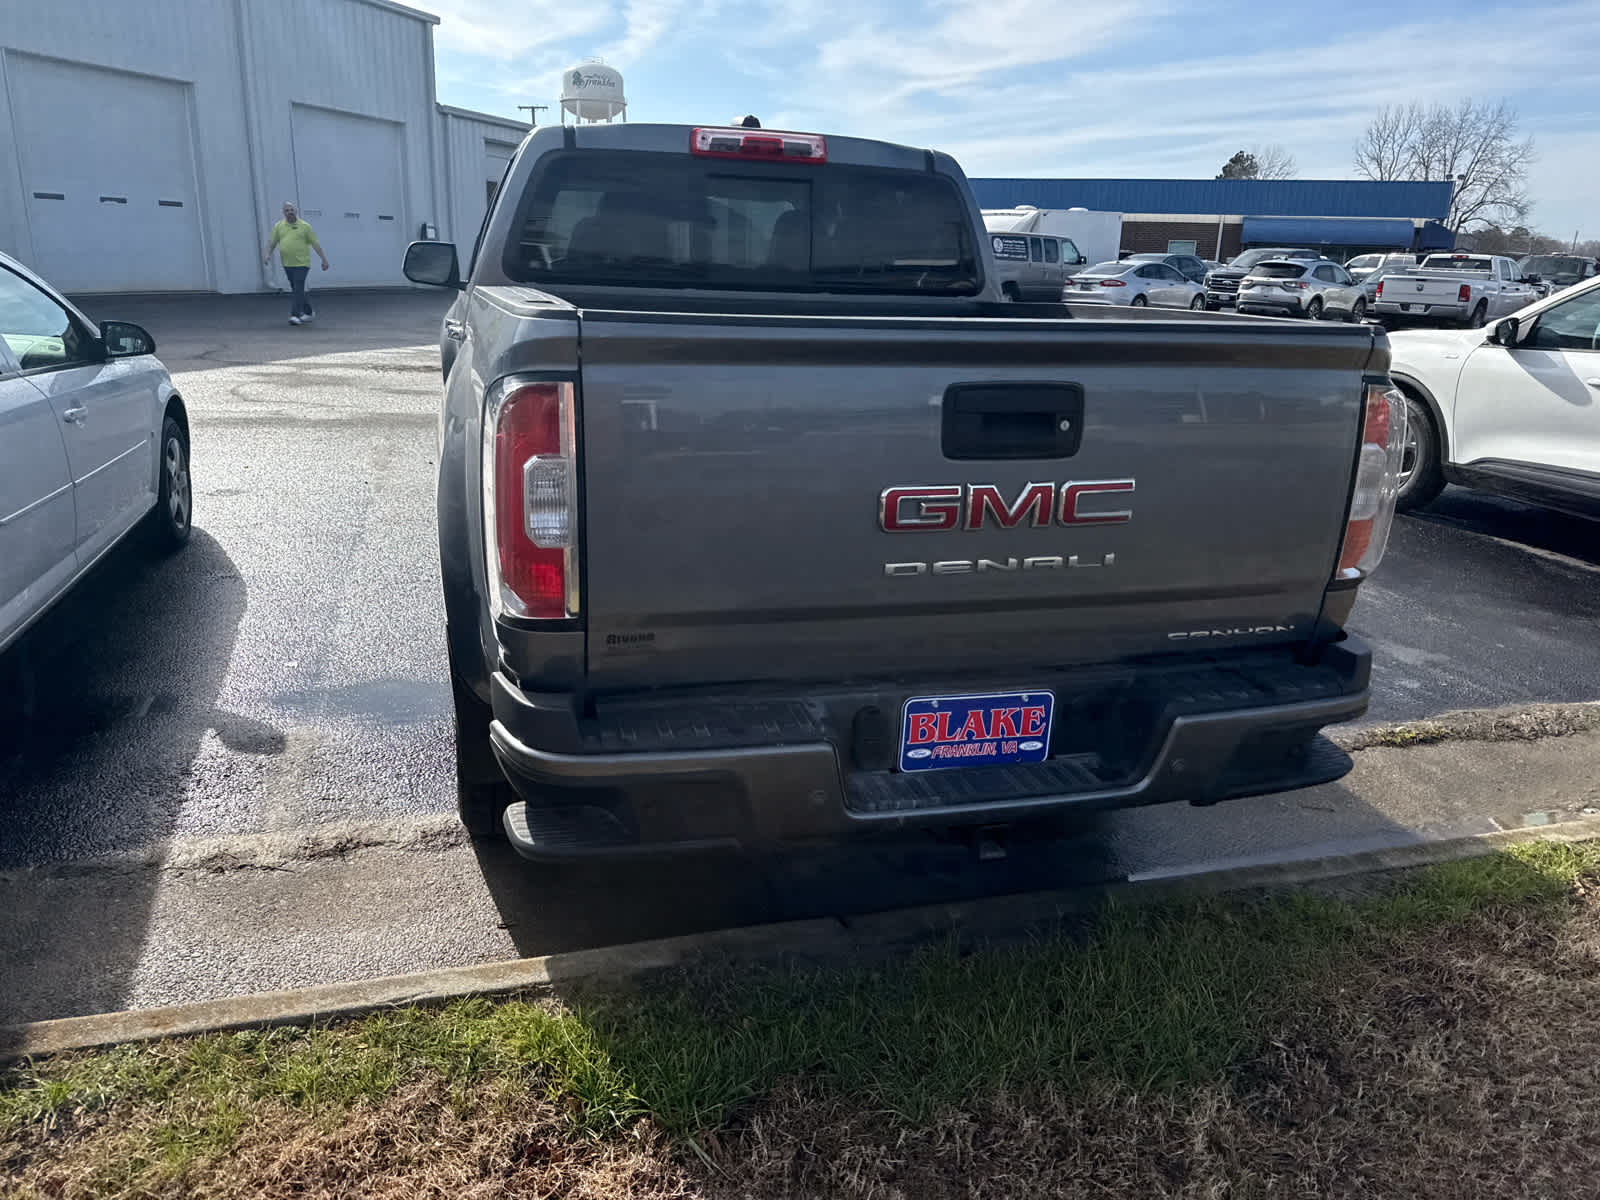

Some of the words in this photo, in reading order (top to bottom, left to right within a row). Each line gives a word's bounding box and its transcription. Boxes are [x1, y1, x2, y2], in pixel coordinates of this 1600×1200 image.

[880, 478, 1136, 533] GMC
[884, 552, 1116, 577] DENALI
[907, 705, 1047, 745] BLAKE
[1001, 740, 1018, 754] VA
